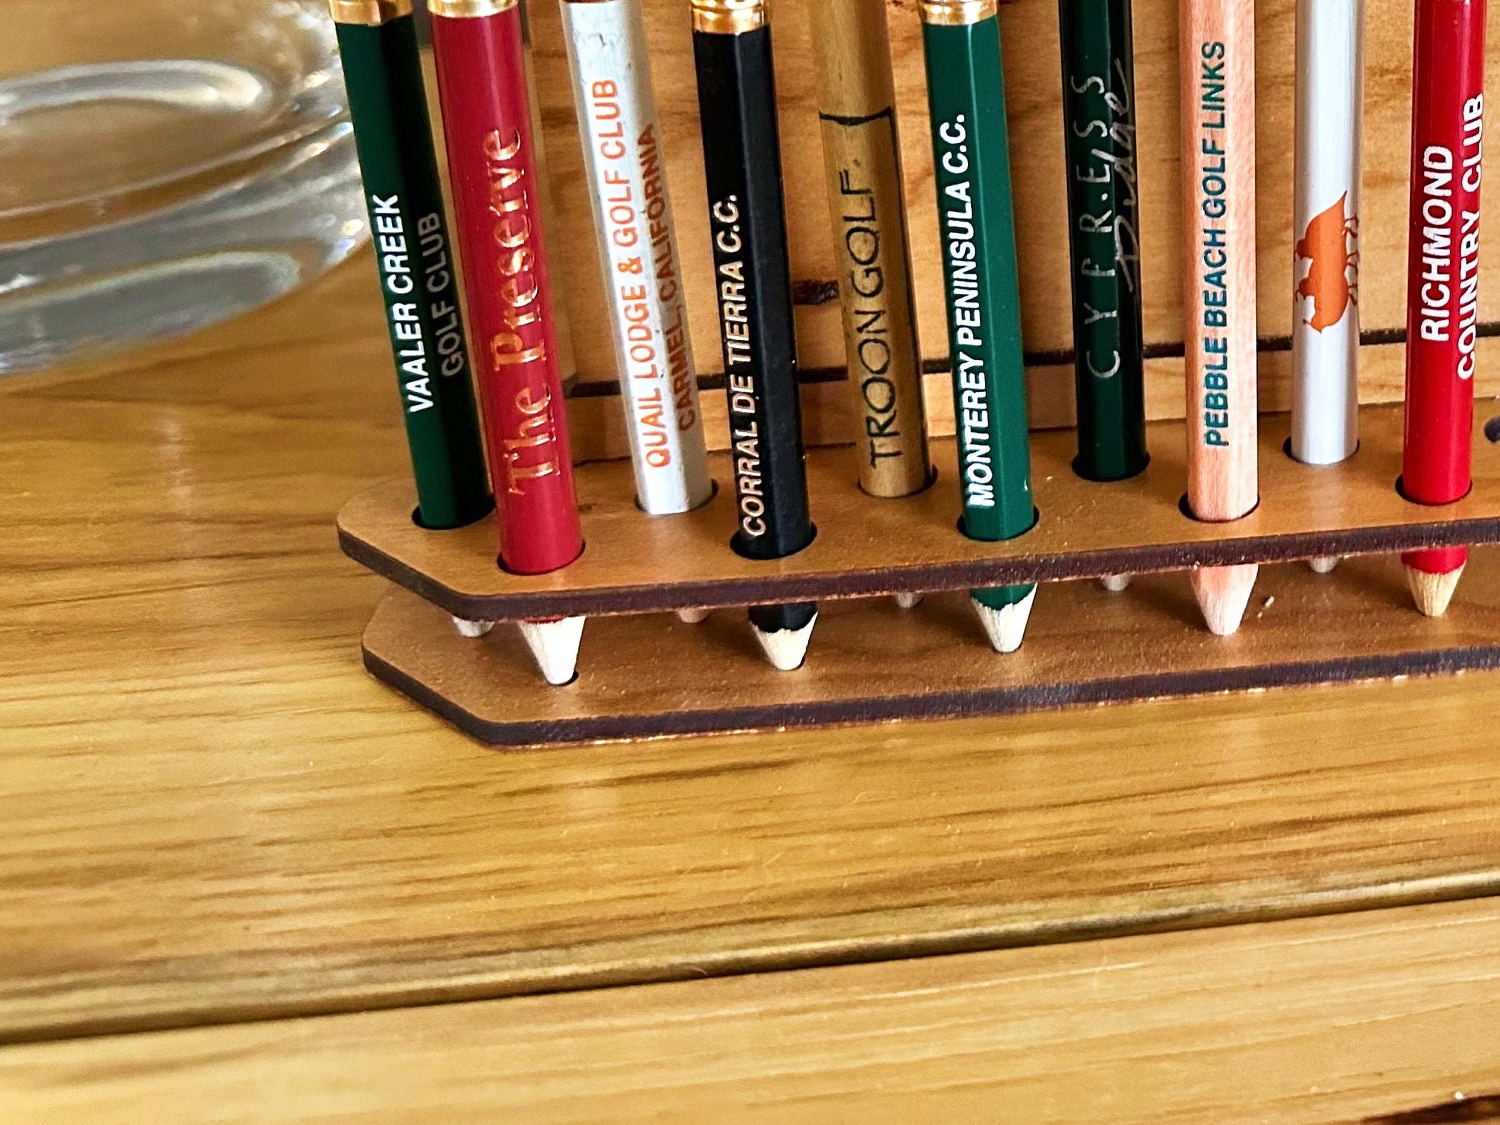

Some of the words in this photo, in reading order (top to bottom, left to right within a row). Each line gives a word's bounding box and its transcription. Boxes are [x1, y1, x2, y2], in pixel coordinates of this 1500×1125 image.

[592, 78, 626, 160] CLUB
[1201, 41, 1225, 129] LINKS
[939, 114, 968, 174] C.C.
[1201, 138, 1226, 219] GOLF
[1461, 93, 1485, 193] CLUB
[372, 194, 414, 294] CREEK
[420, 211, 449, 291] CLUB
[483, 129, 546, 371] Preserve
[605, 168, 637, 247] GOLF
[638, 123, 678, 302] CALIFORNIA
[713, 194, 741, 253] C.C.
[839, 169, 883, 298] GOLF
[1421, 145, 1453, 342] RICHMOND
[617, 257, 643, 274] &
[720, 261, 751, 364] TIERRA
[945, 182, 983, 346] PENINSULA
[1202, 228, 1228, 327] BEACH
[1456, 202, 1481, 380] COUNTRY
[393, 304, 433, 413] VAALER
[431, 299, 464, 377] GOLF
[621, 285, 657, 379] LODGE
[636, 387, 670, 468] QUAIL
[730, 374, 756, 414] DE
[858, 309, 902, 467] TROON
[957, 352, 995, 507] MONTEREY
[1204, 336, 1229, 446] PEBBLE
[505, 384, 560, 494] The
[735, 421, 768, 537] CORRAL
